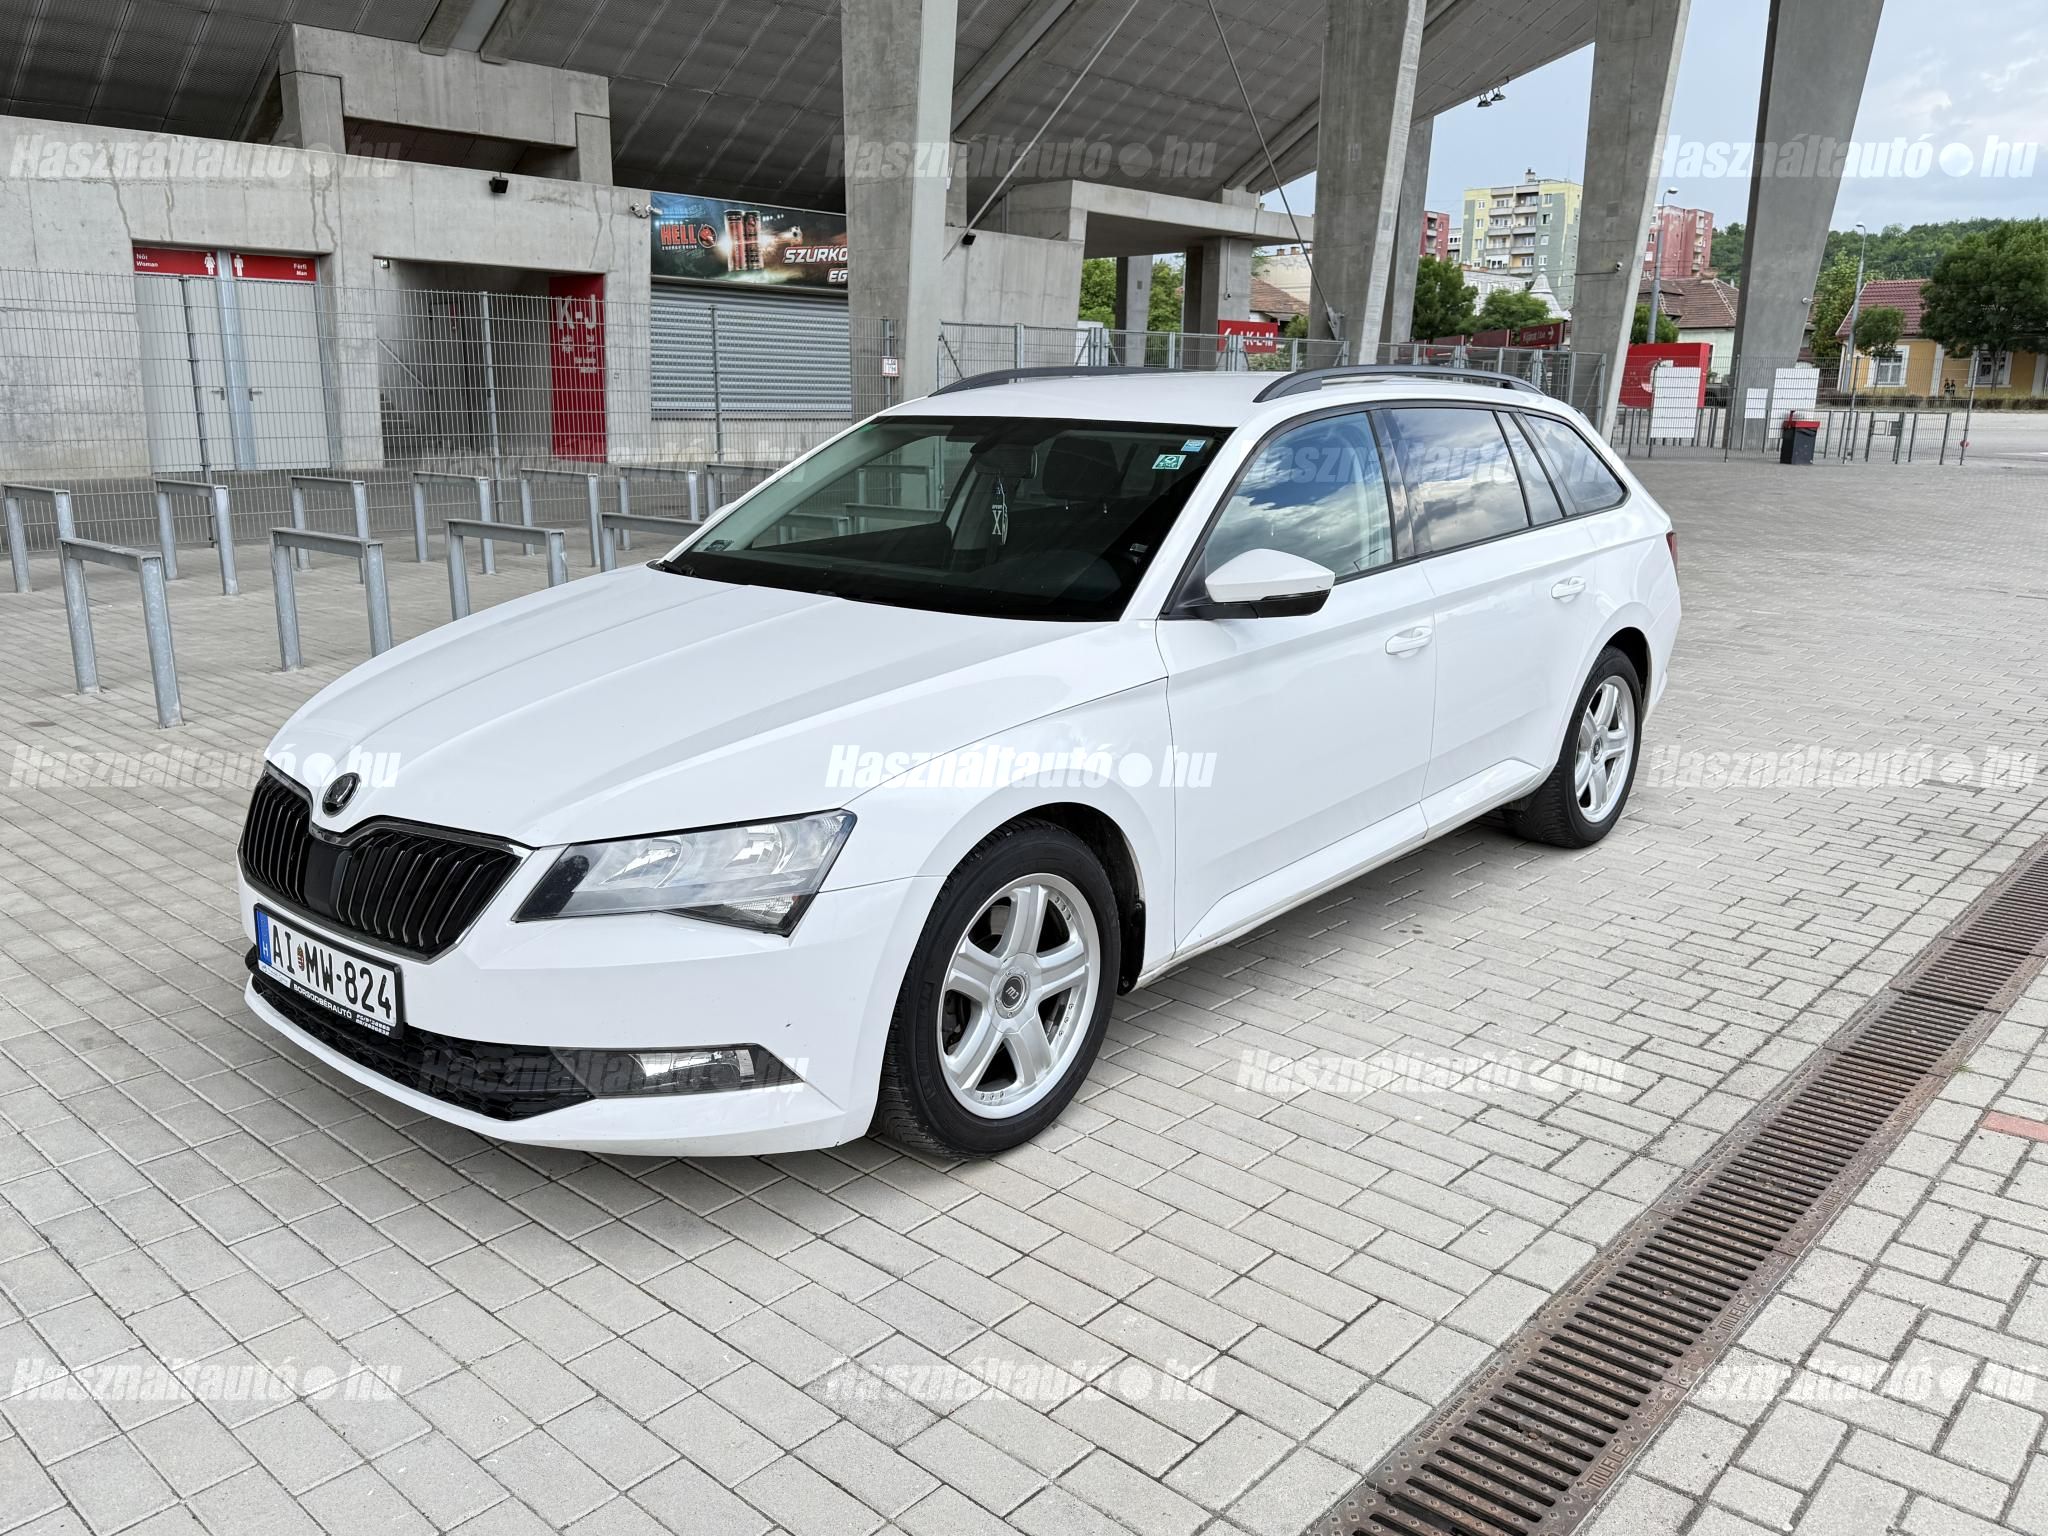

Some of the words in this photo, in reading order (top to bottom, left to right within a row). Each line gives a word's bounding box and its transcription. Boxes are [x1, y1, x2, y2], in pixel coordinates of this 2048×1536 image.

[661, 224, 697, 245] HELL
[263, 943, 269, 957] H
[273, 924, 295, 975] AI
[304, 941, 392, 1019] MW-824
